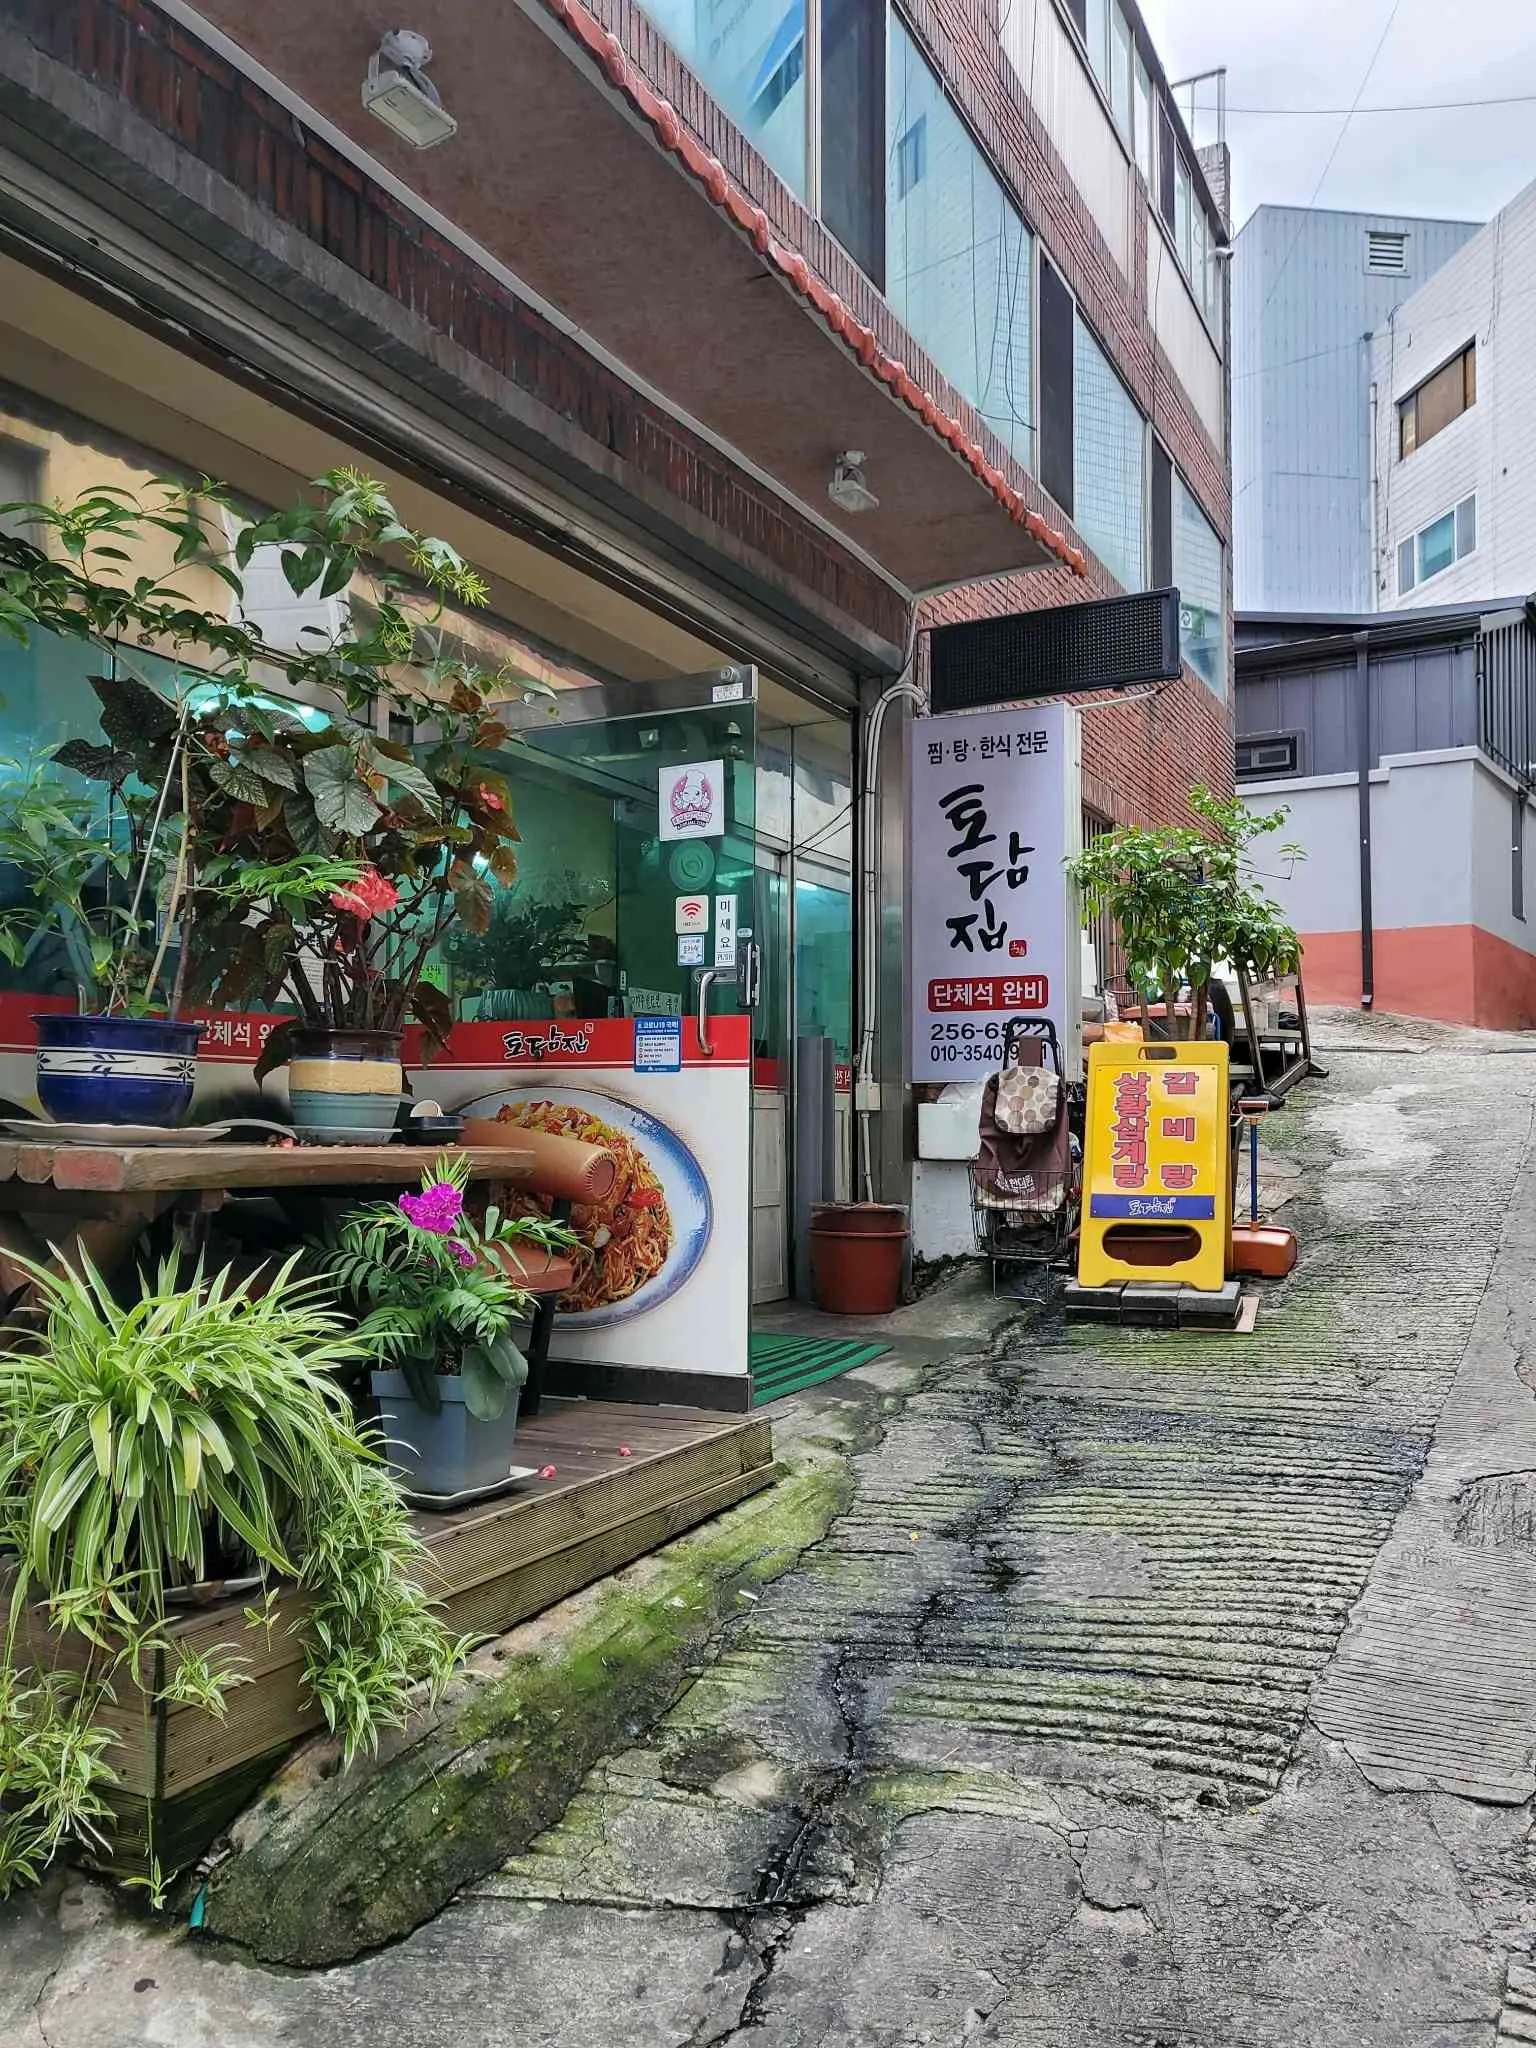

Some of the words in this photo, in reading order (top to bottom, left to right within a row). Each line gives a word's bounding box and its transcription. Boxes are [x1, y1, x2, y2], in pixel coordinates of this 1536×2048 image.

[1016, 730, 1049, 755] 전문
[938, 783, 1035, 953] 토담집
[720, 900, 732, 949] 미세요
[933, 982, 993, 1007] 단체석
[1002, 980, 1043, 1005] 완비
[502, 1024, 590, 1060] 토담집
[930, 1043, 1047, 1061] 010-354091
[1111, 1071, 1151, 1189] 상황삼계탕
[1161, 1071, 1200, 1189] 갈비탕
